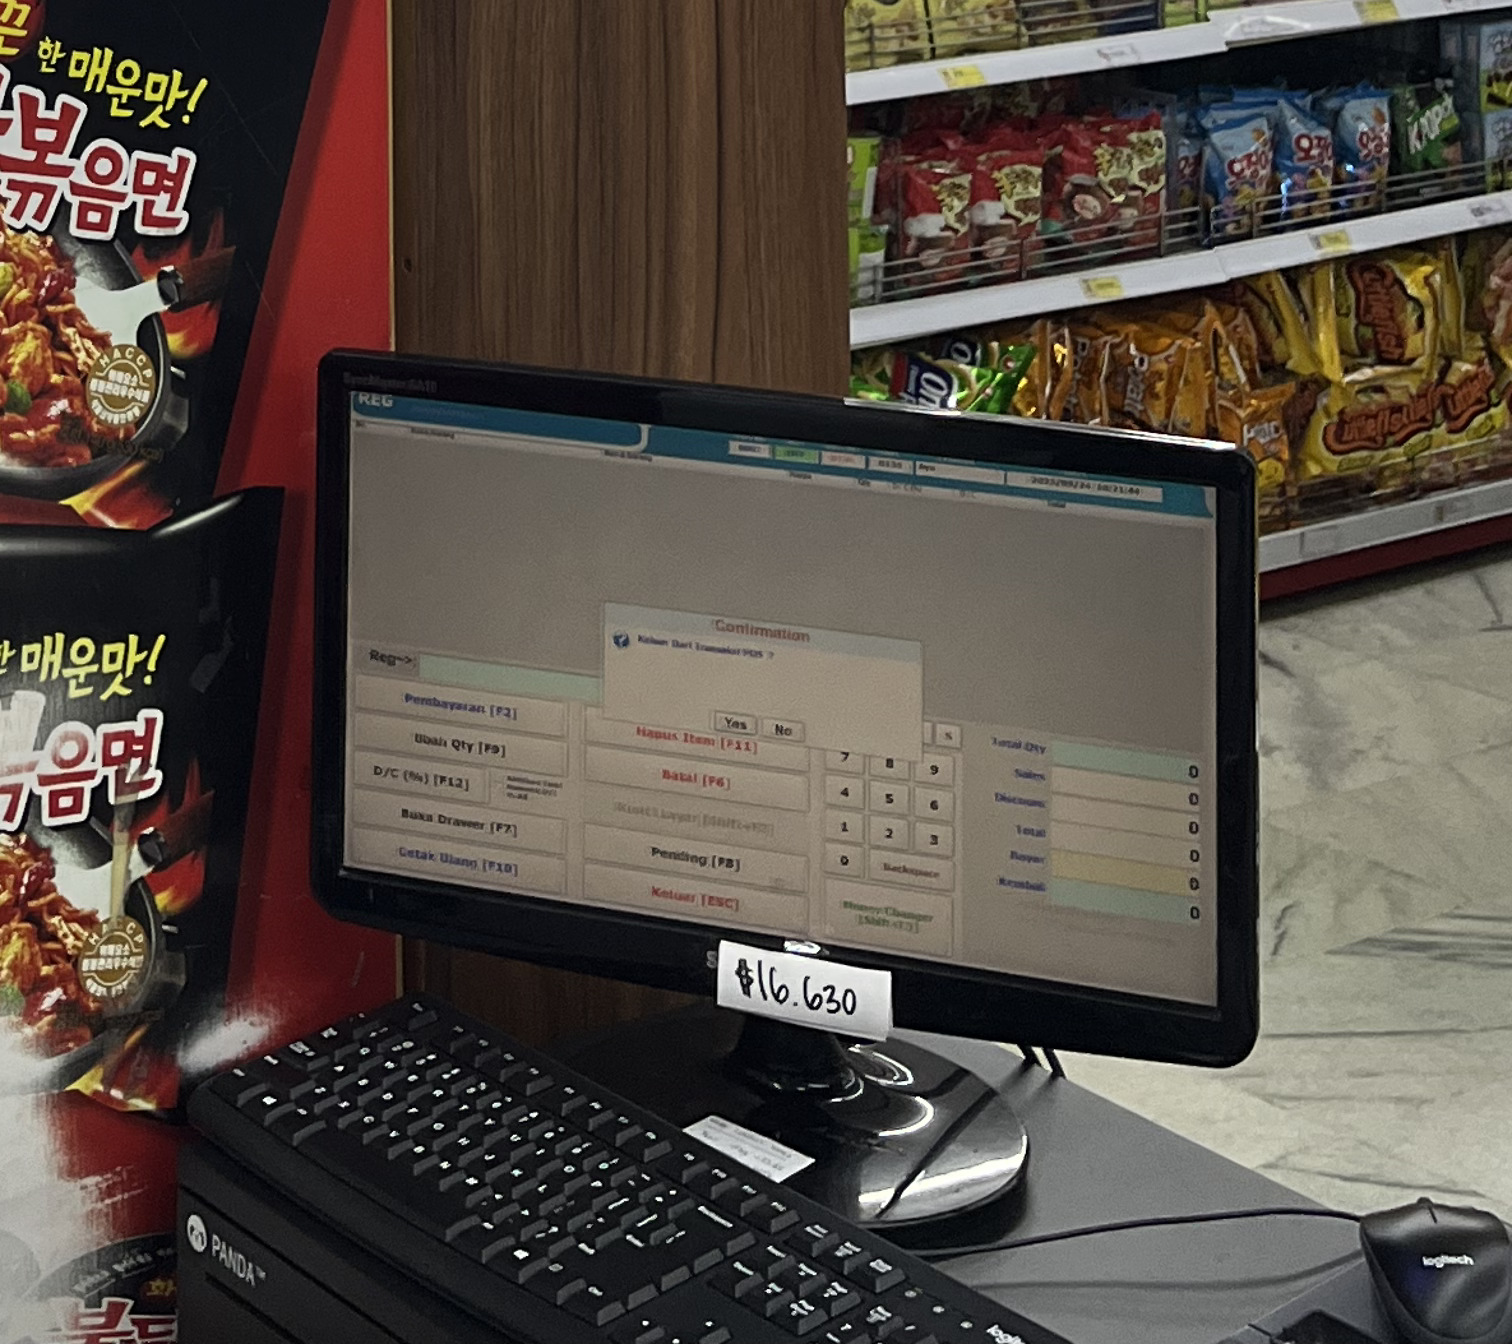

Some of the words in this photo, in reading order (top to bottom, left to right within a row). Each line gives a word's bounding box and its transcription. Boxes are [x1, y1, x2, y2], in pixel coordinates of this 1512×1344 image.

[37, 35, 68, 76] 한
[68, 46, 211, 131] 매운맛!
[99, 348, 152, 378] HACCP
[358, 392, 393, 407] REG
[715, 619, 810, 643] Confirmation
[19, 631, 167, 702] 매운맛!
[724, 717, 747, 731] Yes
[775, 723, 793, 737] No
[683, 732, 715, 746] Item
[373, 766, 399, 779] D/C
[1189, 765, 1199, 778] 0
[1189, 793, 1199, 806] 0
[1189, 821, 1199, 834] 0
[651, 847, 707, 867] Pending
[1190, 849, 1200, 862] 0
[1190, 877, 1200, 891] 0
[1190, 906, 1200, 920] 0
[211, 1234, 256, 1288] PANDA
[1421, 1254, 1474, 1269] logitech
